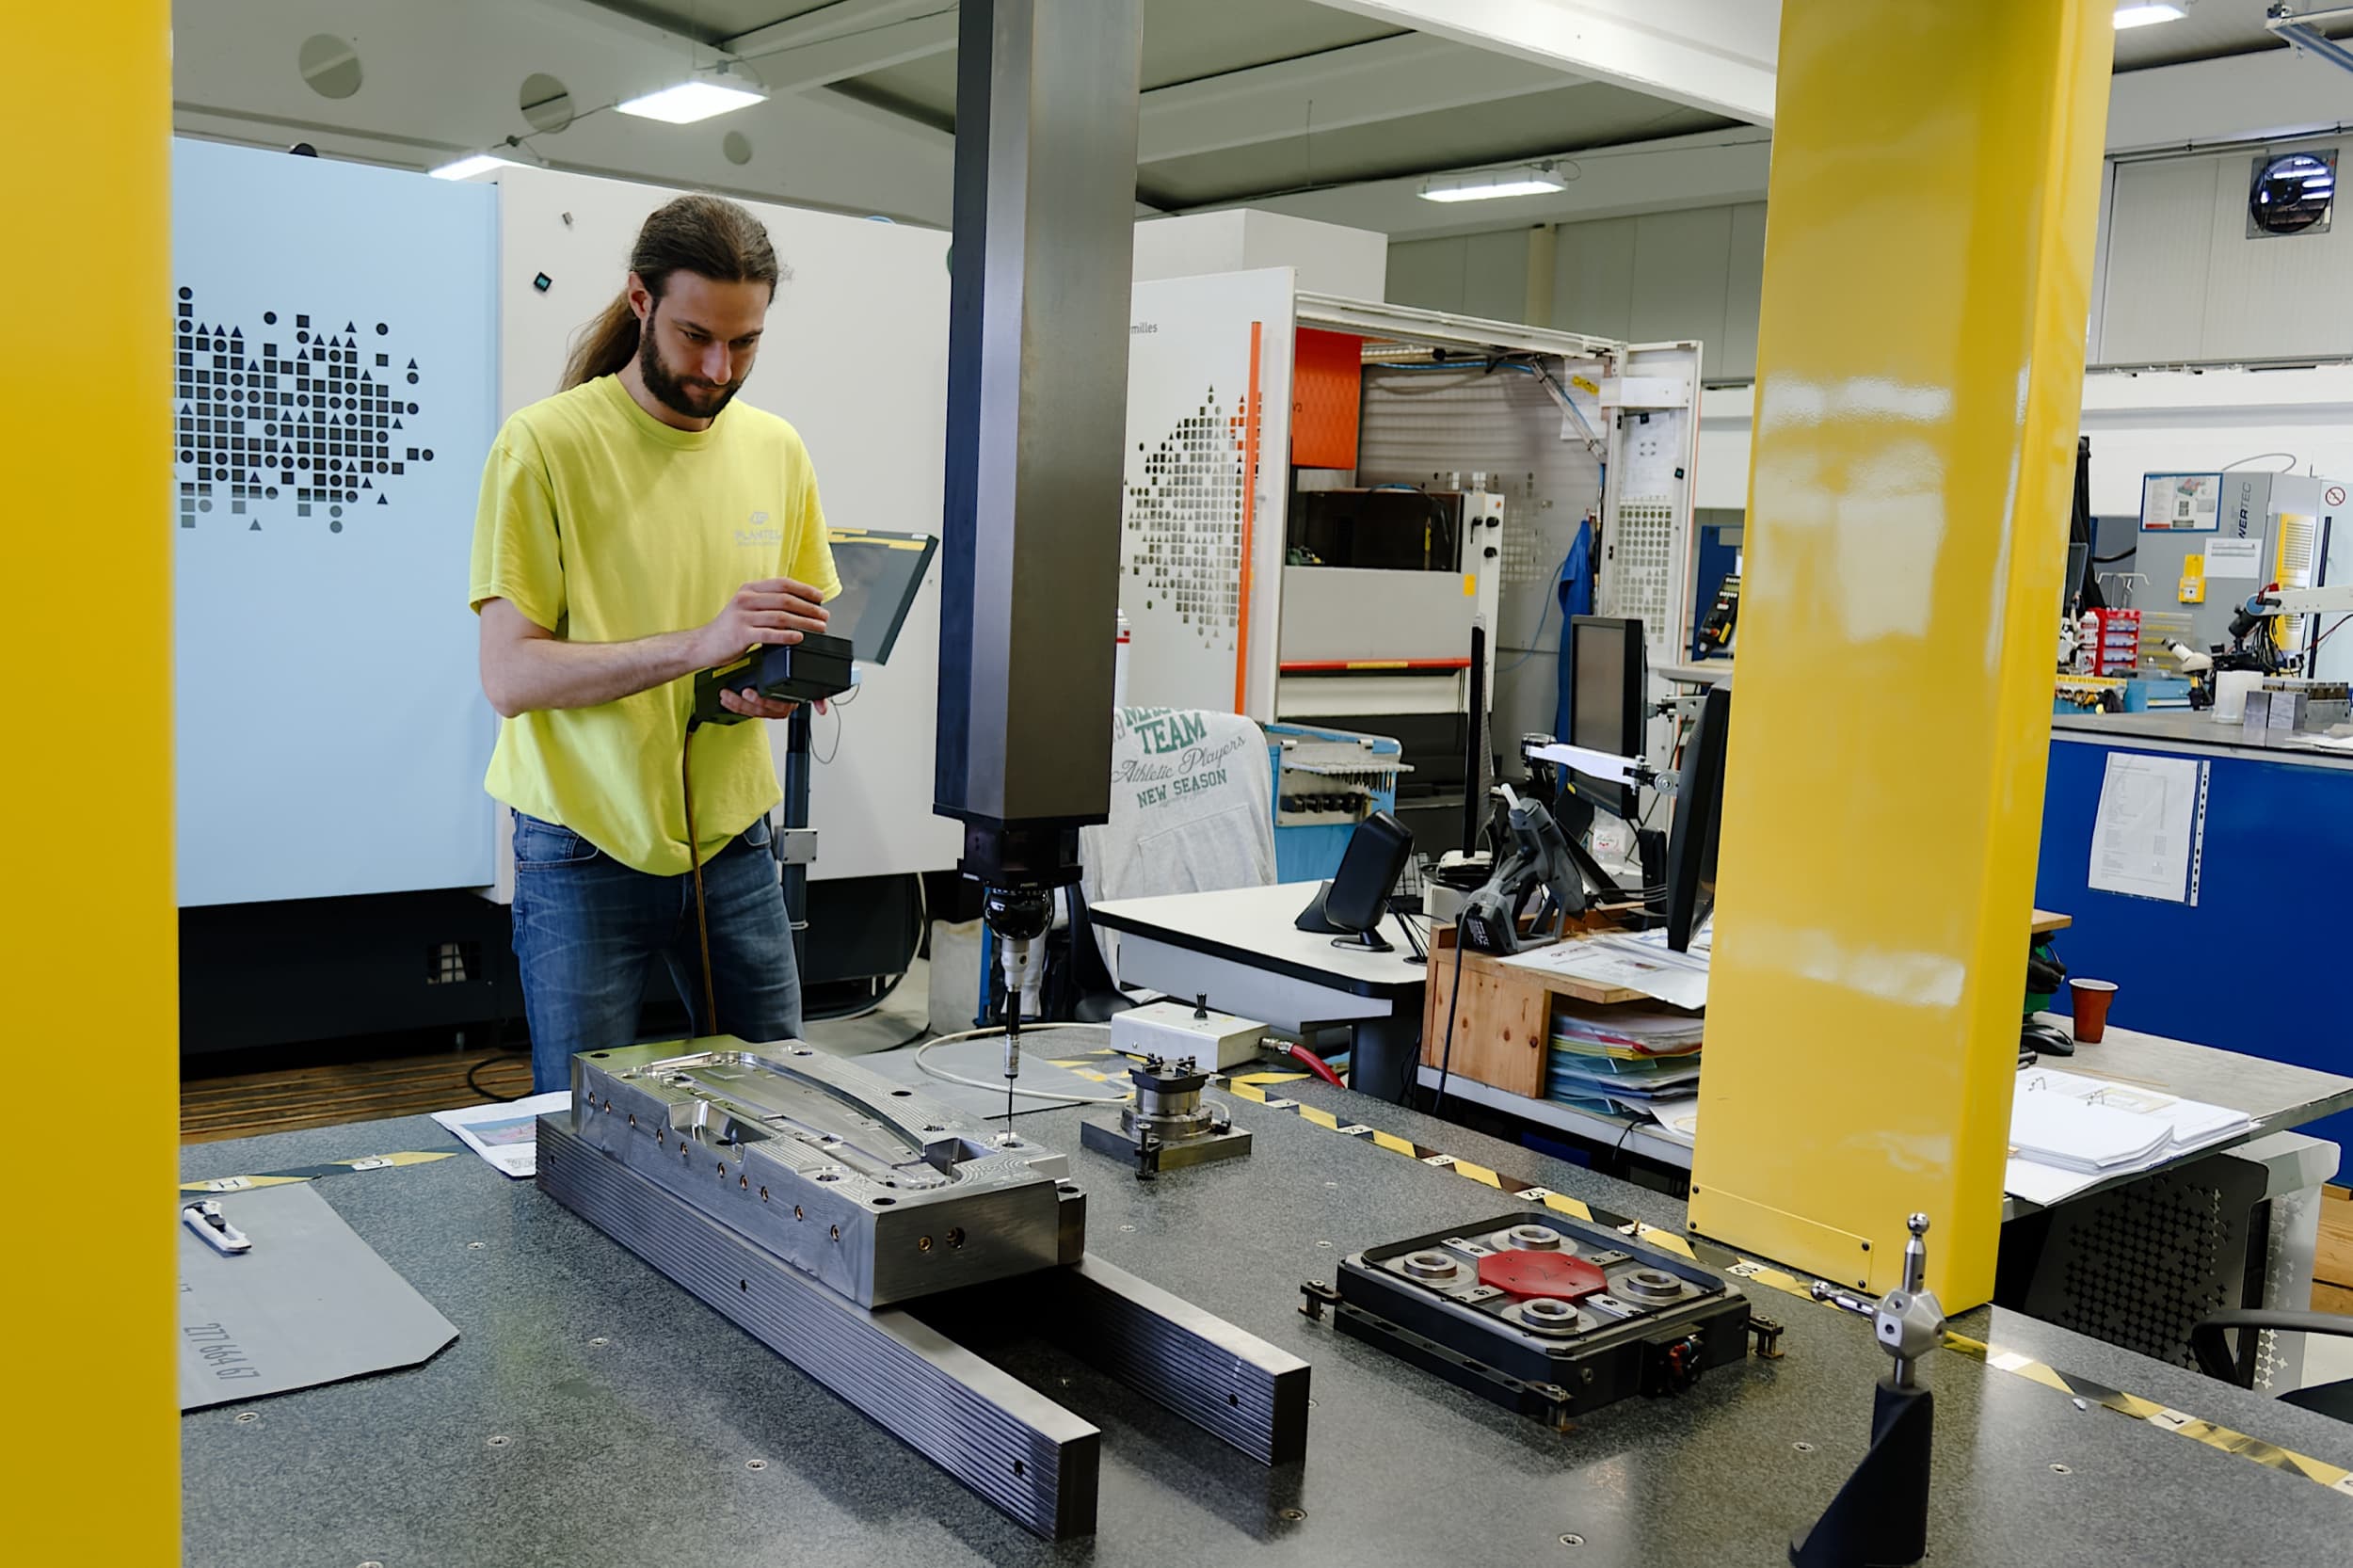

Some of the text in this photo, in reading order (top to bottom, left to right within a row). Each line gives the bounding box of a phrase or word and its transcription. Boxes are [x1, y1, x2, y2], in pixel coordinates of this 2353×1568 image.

[1134, 712, 1208, 755] TEAM
[1112, 735, 1247, 784] Athletic Players
[1137, 784, 1167, 808] NEW
[1173, 769, 1227, 795] SEASON
